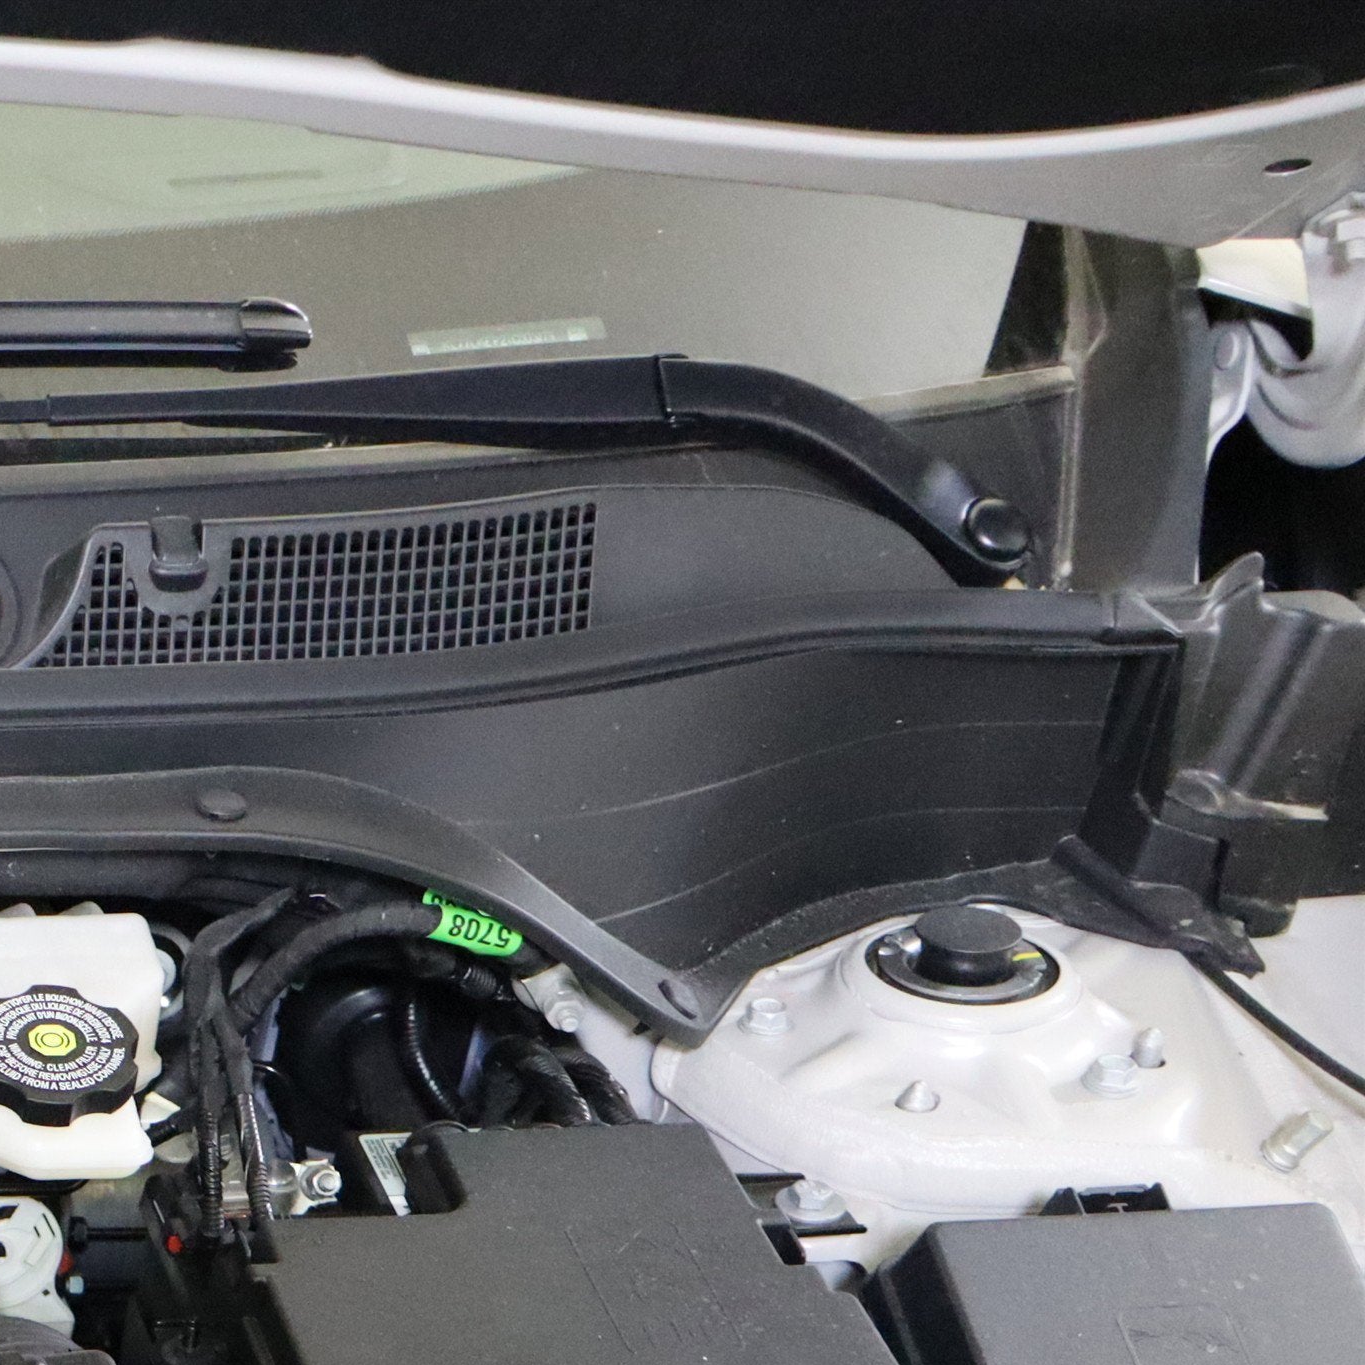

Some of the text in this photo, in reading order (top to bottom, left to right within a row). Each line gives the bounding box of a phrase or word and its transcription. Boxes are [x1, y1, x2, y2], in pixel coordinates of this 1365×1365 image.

[448, 914, 512, 949] 5708
[31, 1002, 43, 1010] DU
[43, 1002, 73, 1013] LIQUIDE
[73, 1007, 85, 1018] DE
[33, 993, 45, 1002] LE
[44, 993, 85, 1009] BOUCHON
[82, 1002, 108, 1019] AVANT
[5, 1056, 39, 1078] BEFORE
[84, 1060, 103, 1074] USE
[95, 1046, 111, 1064] ONLY
[8, 1042, 98, 1072] WARNING: CLEAN FILLER
[20, 1075, 49, 1089] FROM
[50, 1081, 59, 1091] A
[58, 1076, 95, 1091] SEALED
